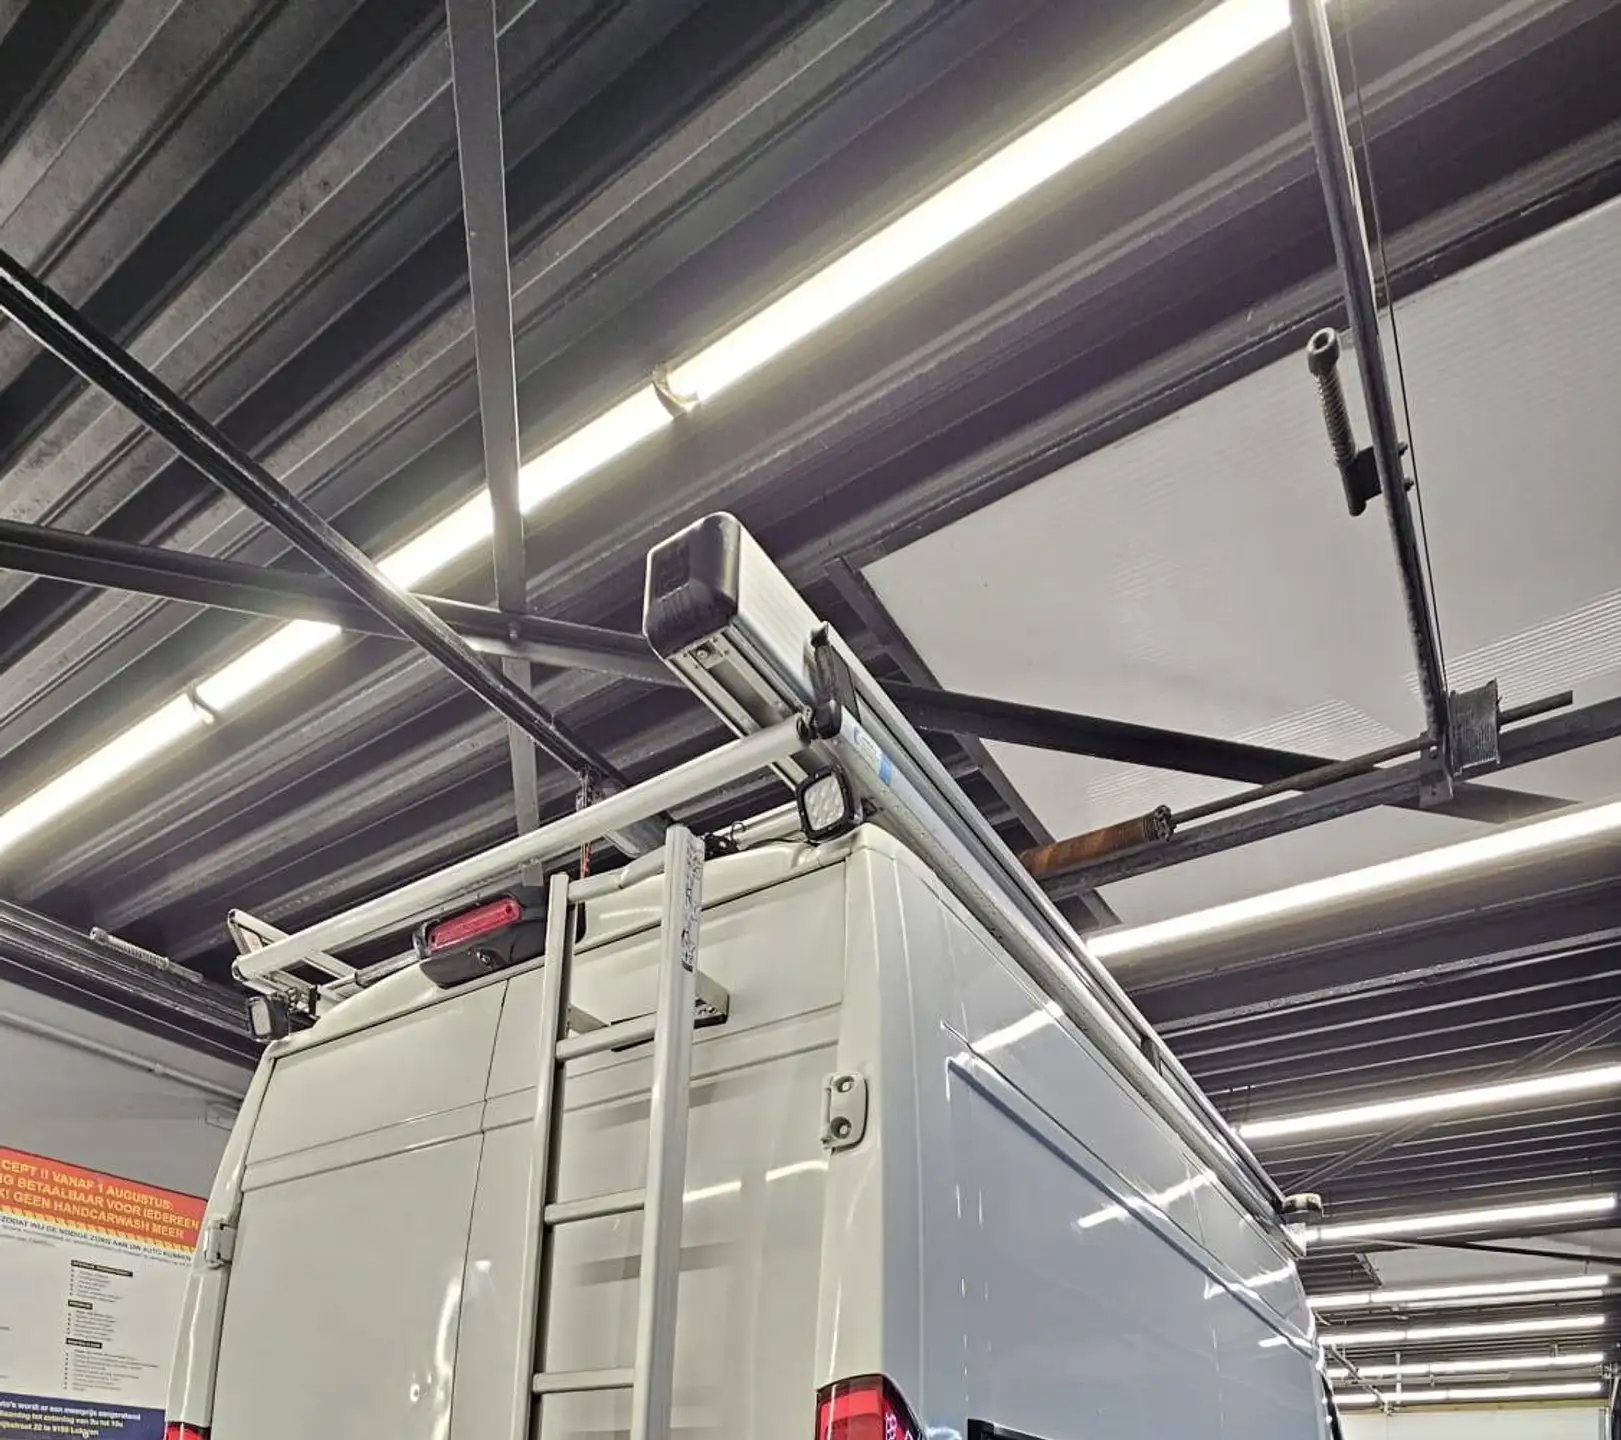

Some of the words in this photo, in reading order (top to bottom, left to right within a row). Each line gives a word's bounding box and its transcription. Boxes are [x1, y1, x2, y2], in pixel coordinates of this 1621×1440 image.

[13, 1191, 50, 1209] GEEN
[54, 1200, 150, 1232] HANDCARWASH
[152, 1222, 184, 1240] MEER
[17, 1178, 104, 1208] BETAALBAAR
[107, 1198, 141, 1217] VOOR
[143, 1208, 200, 1230] IEDEREEN
